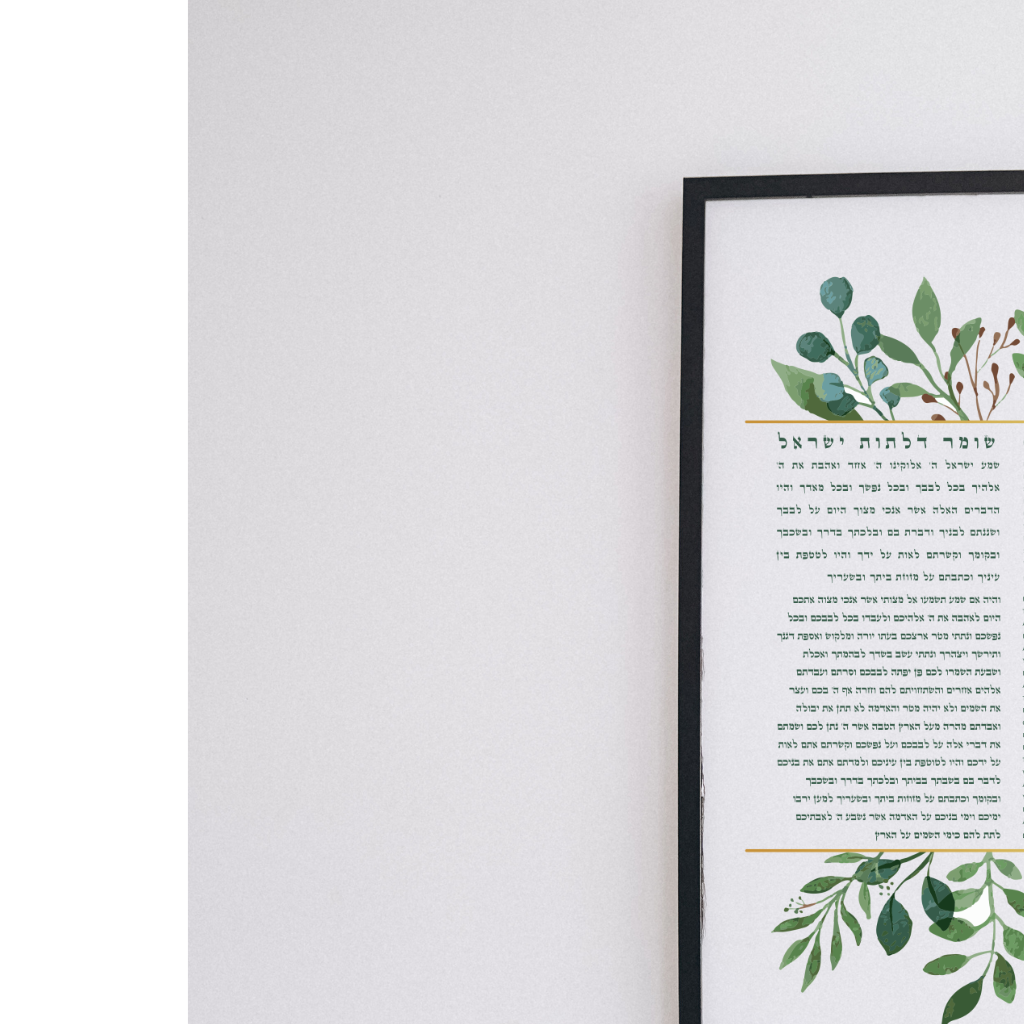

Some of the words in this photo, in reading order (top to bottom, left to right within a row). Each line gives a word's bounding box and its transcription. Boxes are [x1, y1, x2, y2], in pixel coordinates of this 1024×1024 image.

[777, 432, 844, 450] ישראל
[859, 432, 927, 450] דלתות
[942, 434, 996, 450] שומר
[889, 459, 922, 471] אלוקינו
[945, 459, 974, 469] ישראל
[776, 484, 793, 492] והיו
[799, 484, 824, 494] מאדך
[830, 482, 853, 492] ובכל
[858, 484, 881, 494] נפשך
[887, 482, 909, 492] ובכל
[915, 482, 941, 494] לבבך
[947, 482, 965, 492] בכל
[971, 482, 1000, 494] אלהיך
[776, 504, 802, 516] לבבך
[808, 504, 821, 514] על
[826, 506, 847, 514] היום
[853, 506, 876, 516] מצוך
[882, 506, 901, 514] אנכי
[907, 506, 926, 514] אשר
[932, 504, 958, 514] האלה
[964, 506, 1000, 514] הדברים
[776, 528, 812, 538] ובשכבך
[817, 528, 843, 538] בדרך
[848, 526, 883, 538] ובלכתך
[887, 528, 900, 536] בם
[904, 528, 934, 536] ודברת
[939, 526, 965, 538] לבניך
[969, 528, 1001, 536] ושננתם
[775, 550, 790, 560] בין
[795, 548, 828, 560] לטטפת
[834, 552, 851, 560] והיו
[857, 552, 874, 560] ידך
[880, 548, 892, 560] על
[897, 548, 920, 560] לאות
[926, 550, 962, 560] וקשרתם
[968, 552, 1001, 562] ובקומך
[826, 572, 866, 584] ובשעריך
[870, 574, 892, 584] ביתך
[895, 572, 919, 582] מזוזת
[923, 570, 935, 582] על
[938, 574, 974, 582] וכתבתם
[977, 572, 1000, 584] עיניך
